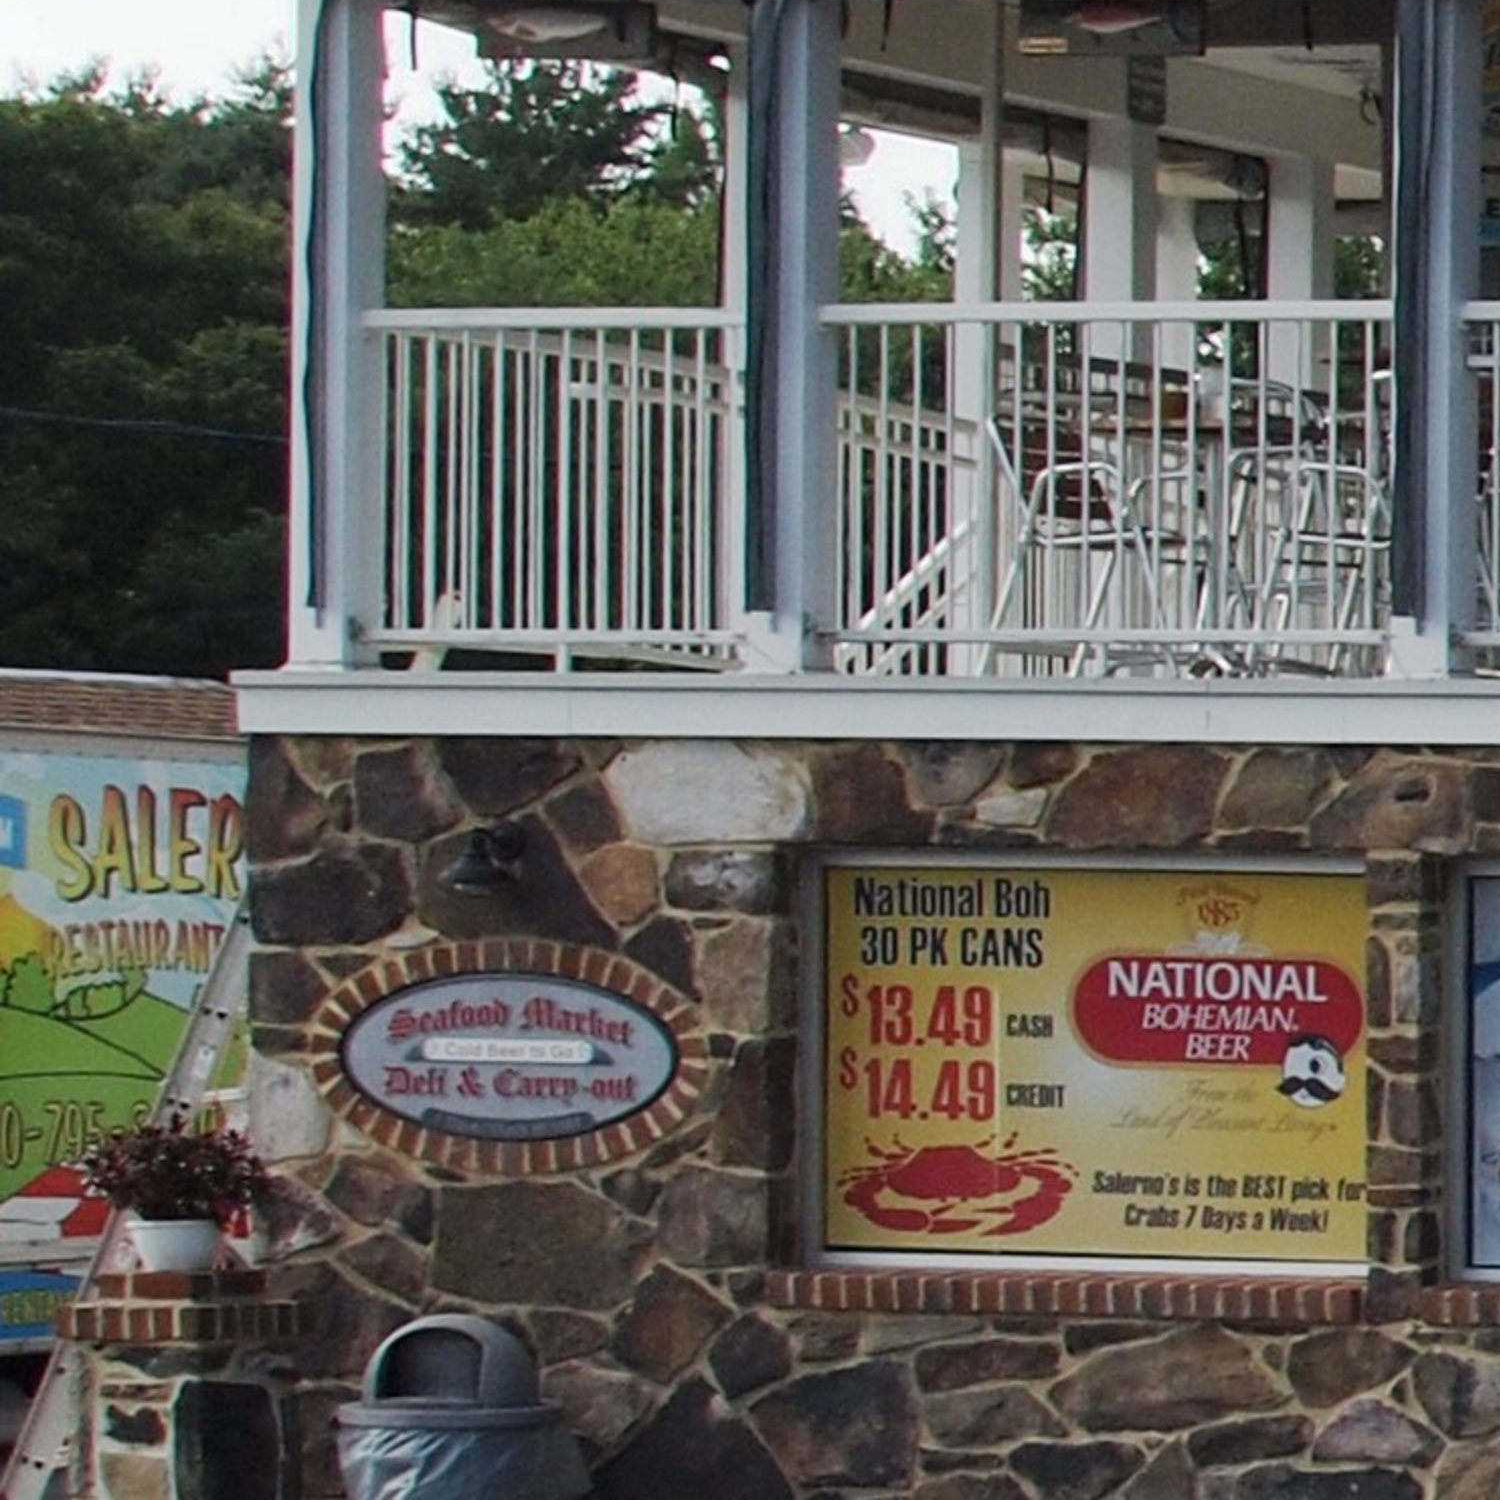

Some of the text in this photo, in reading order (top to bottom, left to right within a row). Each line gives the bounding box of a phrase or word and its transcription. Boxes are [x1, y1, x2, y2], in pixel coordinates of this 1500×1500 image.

[854, 876, 1050, 918] National Boh
[51, 918, 225, 975] RESTAURANT
[861, 926, 1043, 968] 30 PK CANS
[1108, 960, 1328, 1003] NATIONAL
[389, 997, 635, 1043] Seafood Market
[1006, 1013, 1054, 1038] CASH
[1142, 1002, 1298, 1033] BOHEMIAN
[445, 1040, 483, 1057] Cold
[487, 1041, 526, 1058] Beer
[530, 1043, 546, 1058] to
[1185, 1033, 1251, 1060] BEER
[384, 1066, 637, 1105] Deli & Carry-out
[1006, 1083, 1066, 1108] CREDIT
[1092, 1170, 1180, 1195] Salerno's
[1183, 1171, 1200, 1196] is
[1207, 1174, 1237, 1198] the
[1241, 1175, 1287, 1199] BEST
[1291, 1177, 1329, 1204] pick
[1124, 1203, 1329, 1234] Crabs 7 Days a Week!
